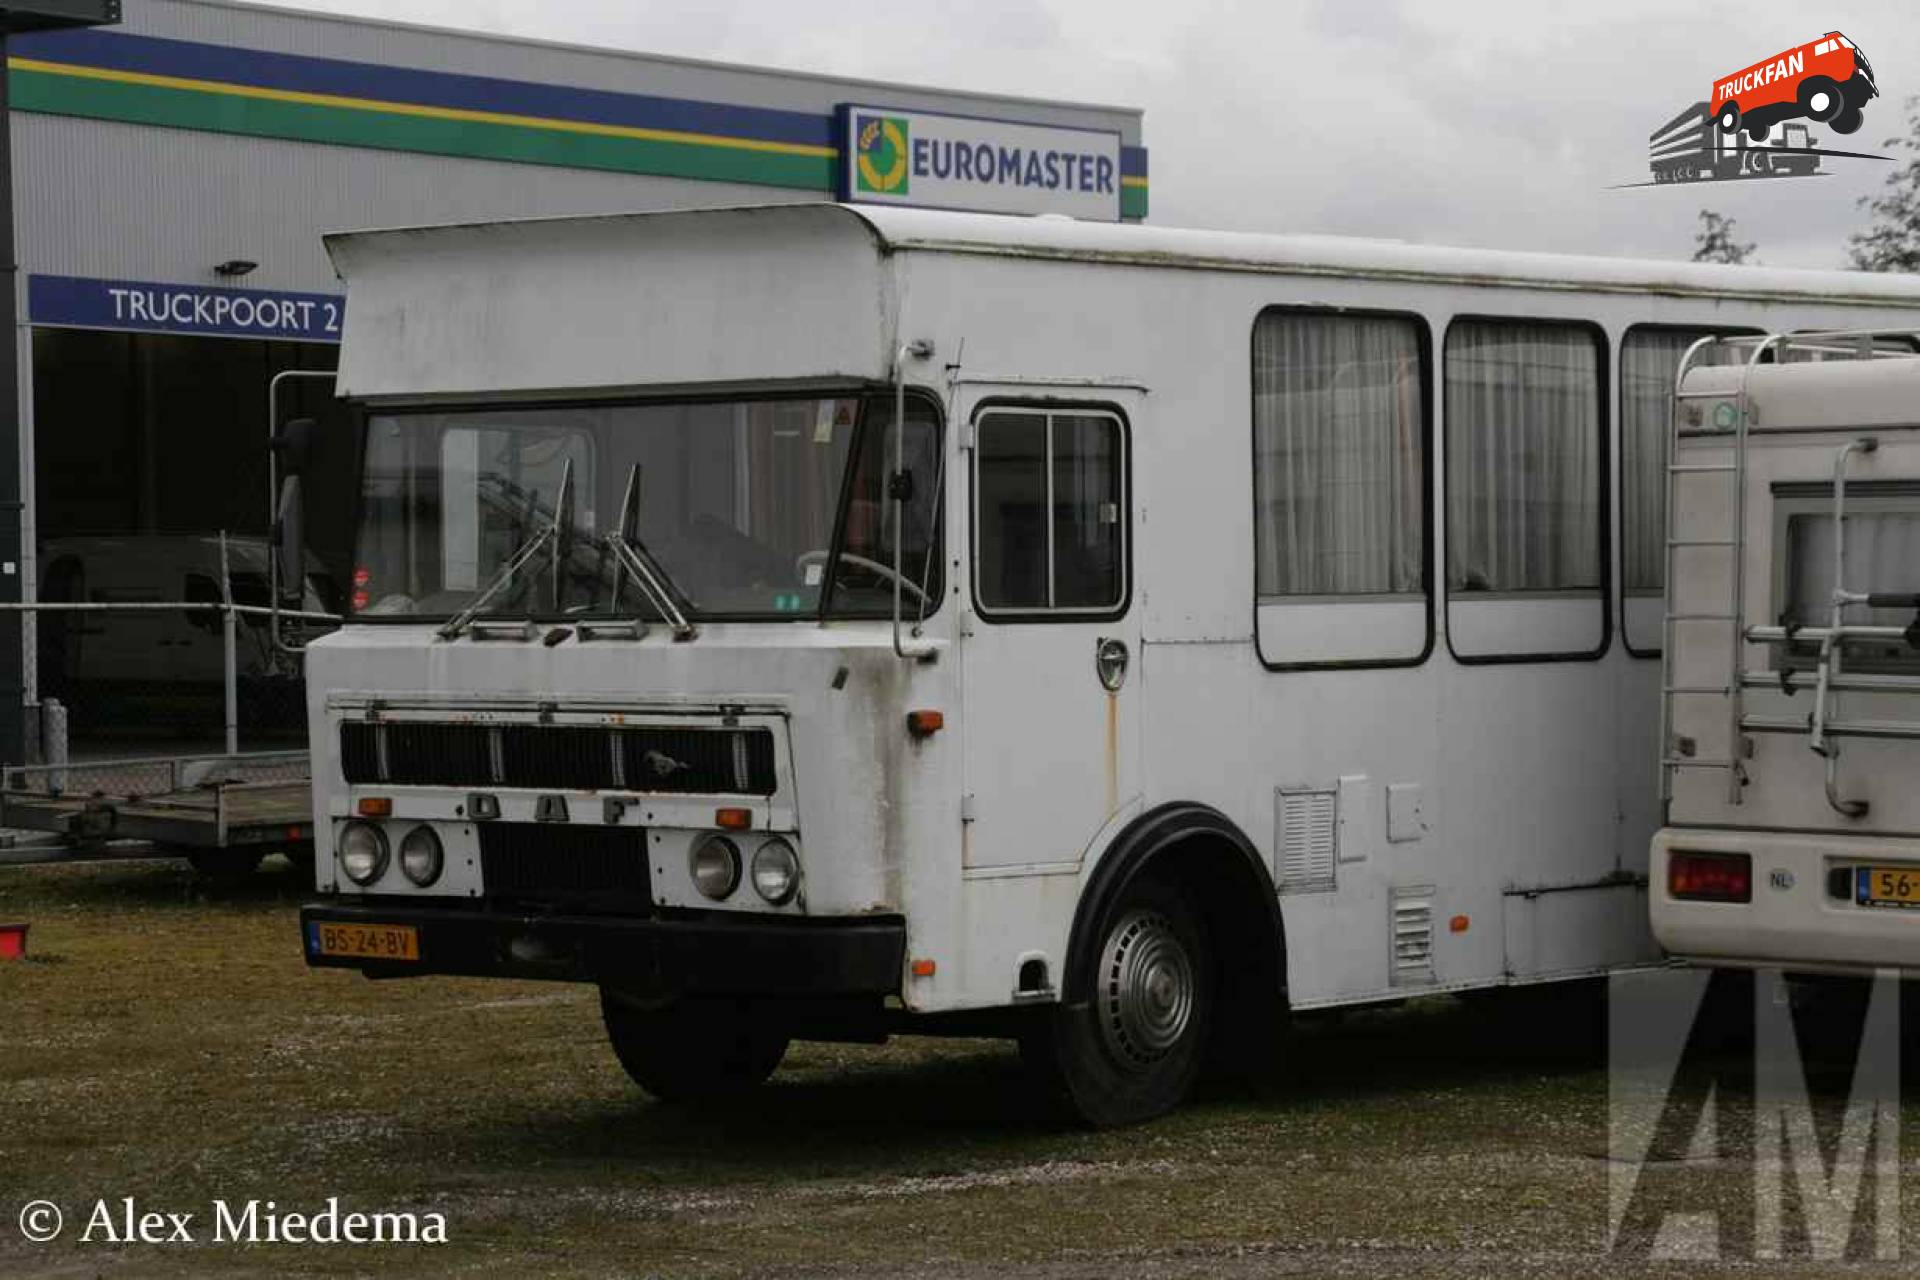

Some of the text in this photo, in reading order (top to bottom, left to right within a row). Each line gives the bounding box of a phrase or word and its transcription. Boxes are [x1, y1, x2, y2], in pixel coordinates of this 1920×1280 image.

[912, 137, 1115, 194] EUROMASTER
[109, 288, 339, 332] TRUCKPOORT 2
[467, 793, 640, 825] DAF
[324, 927, 409, 955] BS-24-BV
